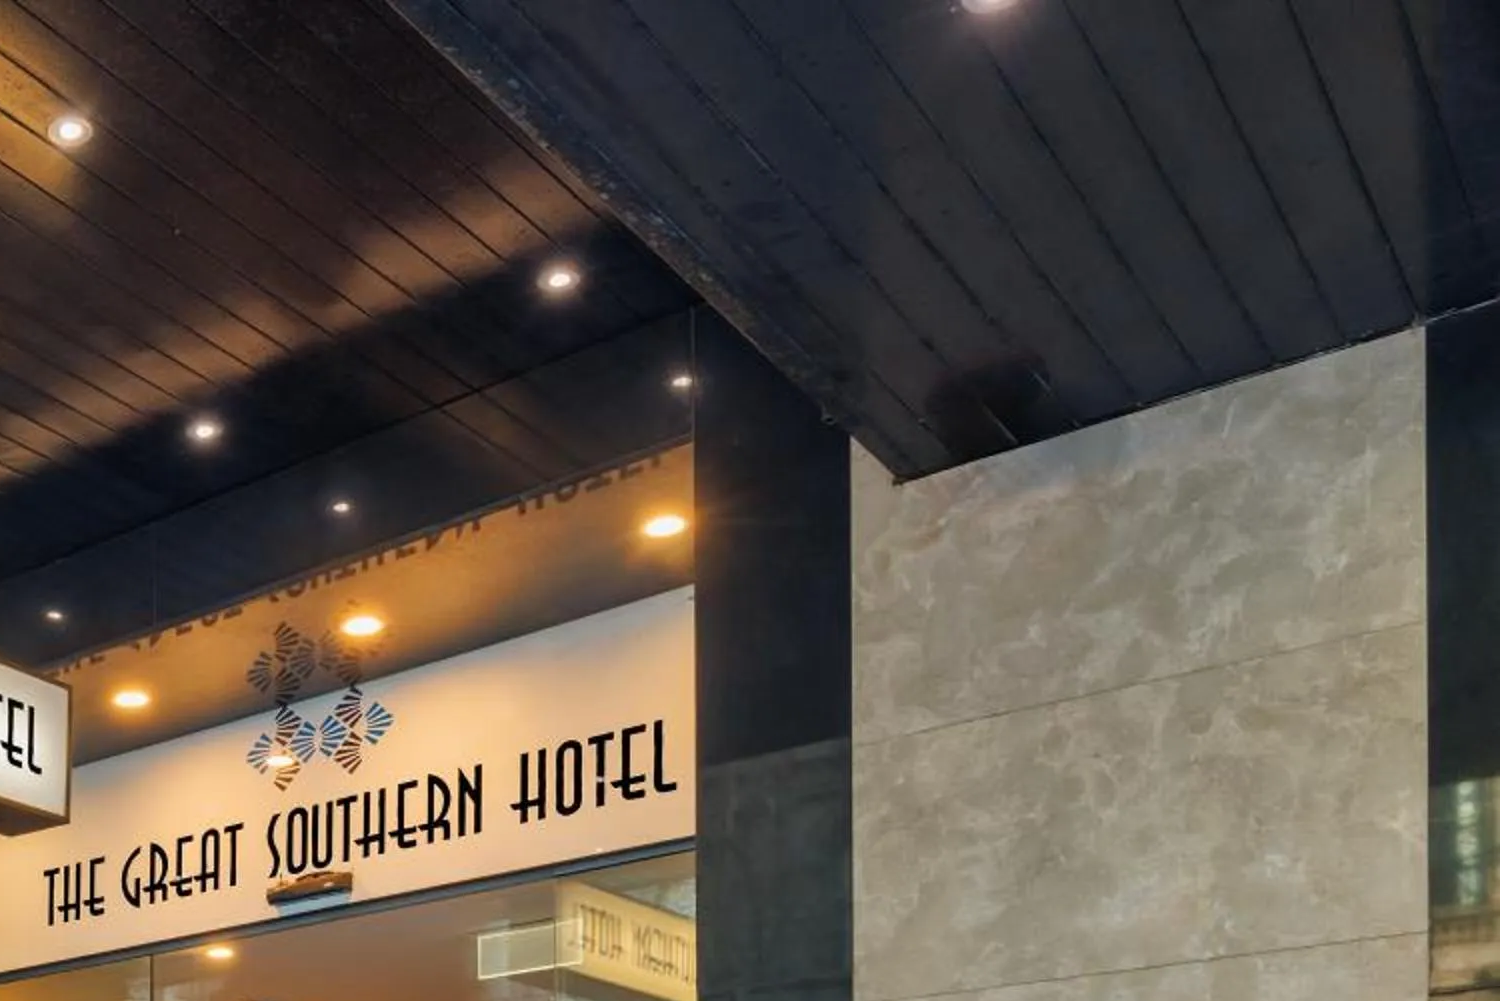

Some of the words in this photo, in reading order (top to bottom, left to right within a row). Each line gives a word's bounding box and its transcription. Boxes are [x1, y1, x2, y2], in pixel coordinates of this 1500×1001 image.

[43, 856, 105, 926] THE
[120, 822, 244, 908] GREAT
[266, 764, 484, 879] SOUTHERN
[510, 719, 678, 825] HOTEL
